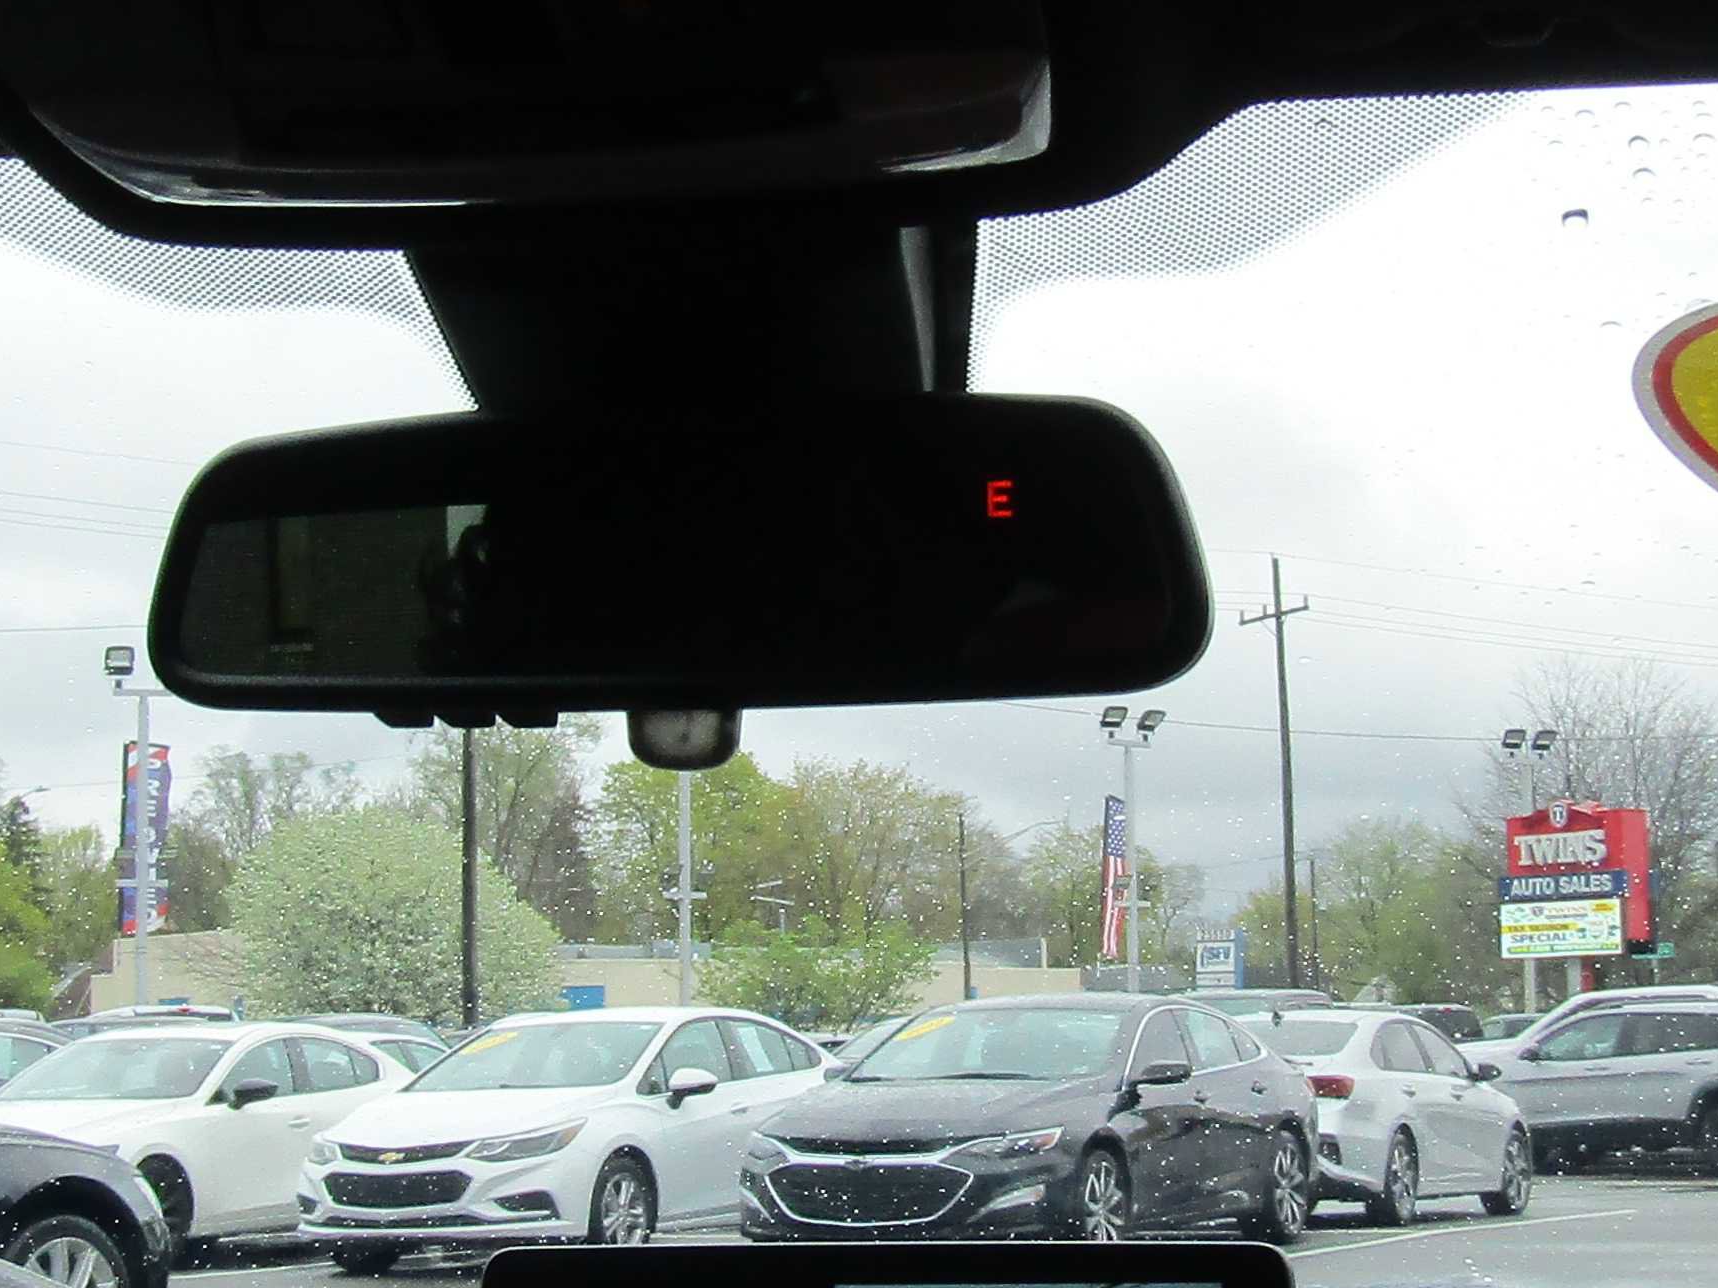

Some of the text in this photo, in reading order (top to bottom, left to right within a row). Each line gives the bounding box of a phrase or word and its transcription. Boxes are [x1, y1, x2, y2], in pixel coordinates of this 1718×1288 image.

[987, 479, 1012, 518] E
[1514, 829, 1608, 866] TWINS
[1511, 874, 1613, 897] AUTO SALES
